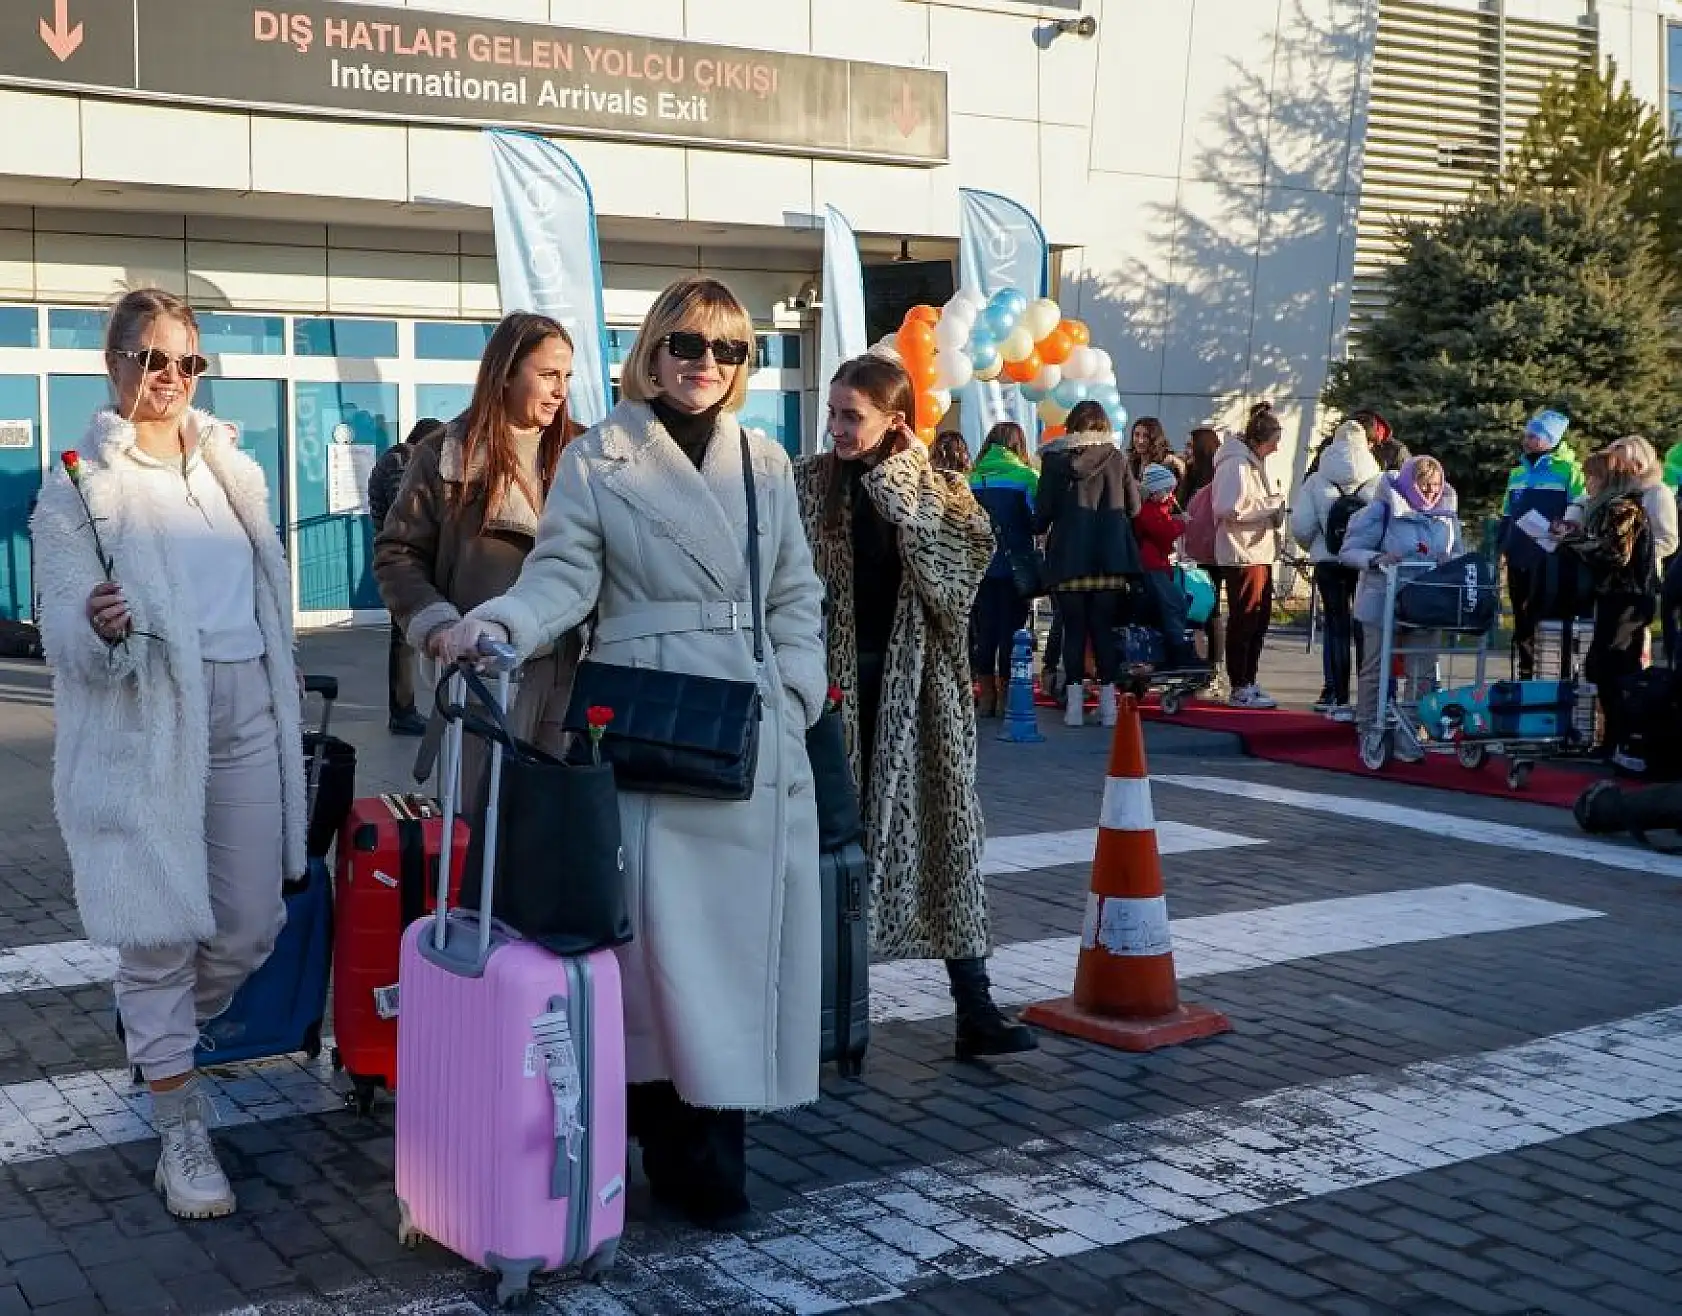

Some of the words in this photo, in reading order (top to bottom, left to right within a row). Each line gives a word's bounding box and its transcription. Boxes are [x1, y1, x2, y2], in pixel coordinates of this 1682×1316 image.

[254, 10, 314, 53] DIŞ
[325, 17, 458, 59] HATLAR
[467, 33, 574, 72] GELEN
[582, 45, 685, 84] YOLCU
[693, 58, 779, 99] ÇIKIŞI
[331, 58, 526, 105] International
[536, 79, 649, 117] Arrivals
[657, 91, 709, 122] Exit
